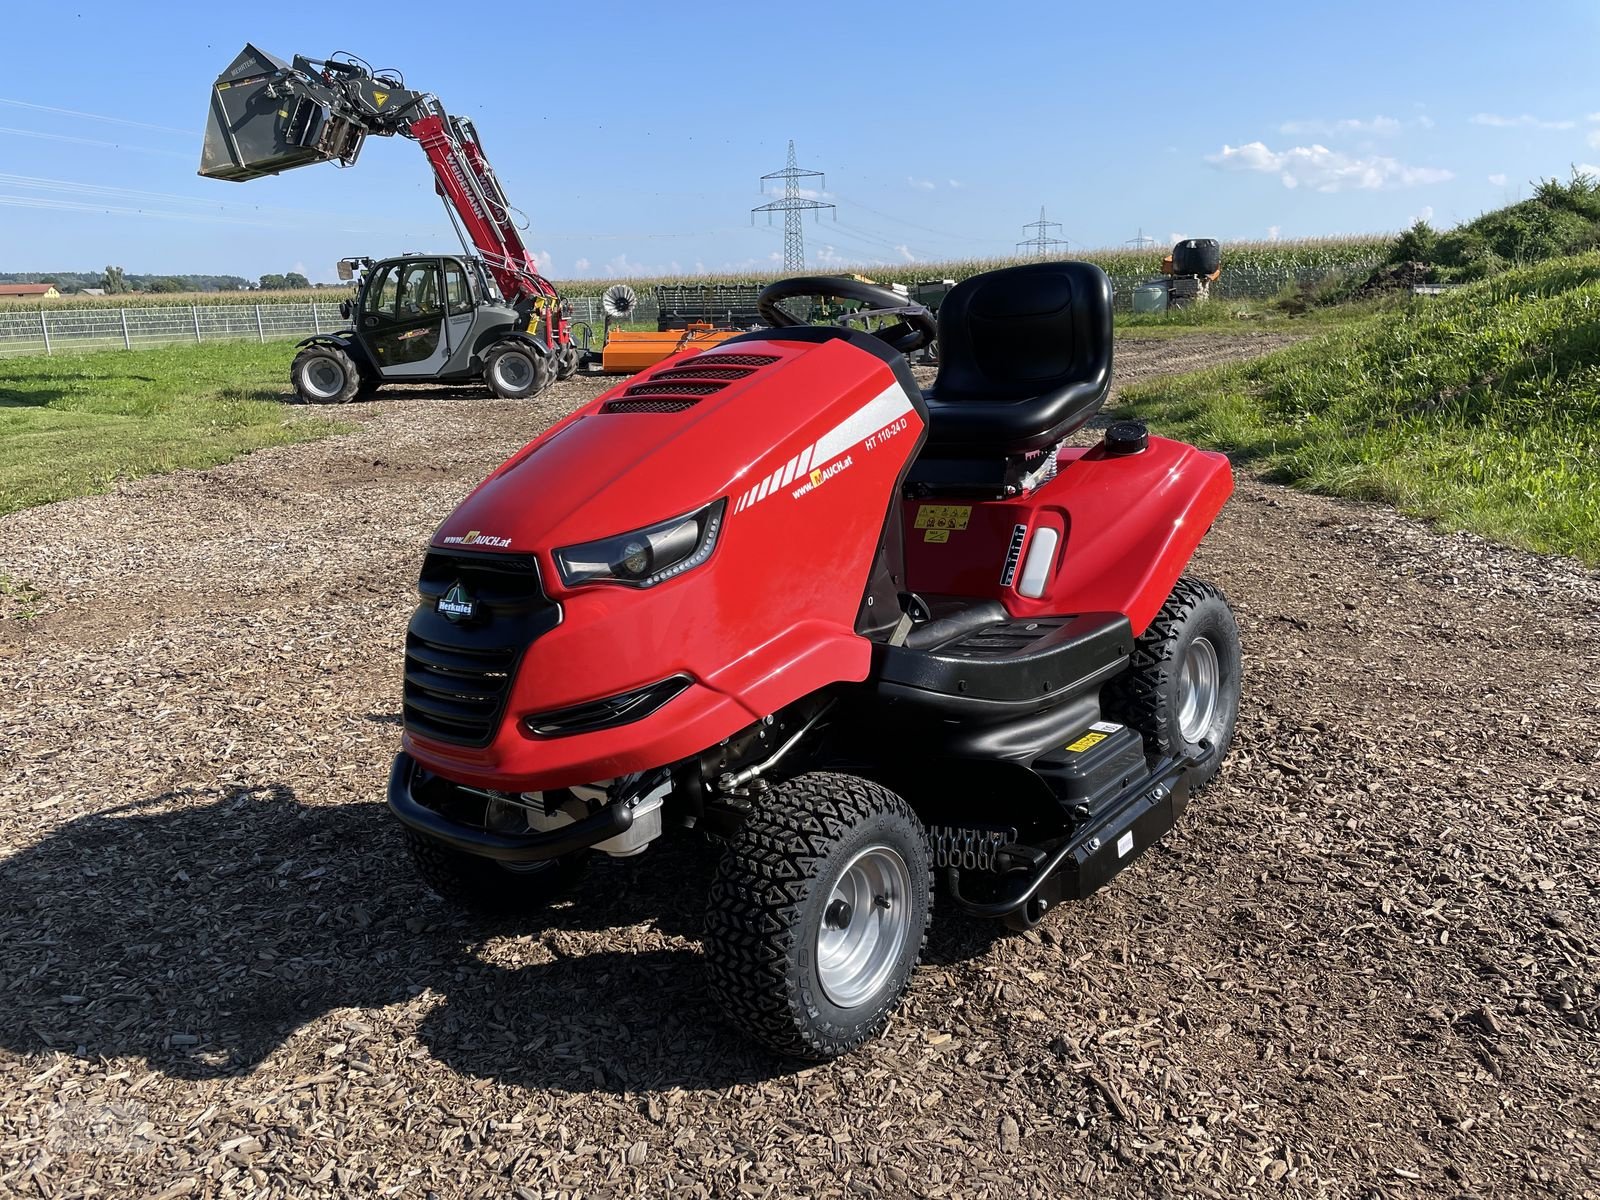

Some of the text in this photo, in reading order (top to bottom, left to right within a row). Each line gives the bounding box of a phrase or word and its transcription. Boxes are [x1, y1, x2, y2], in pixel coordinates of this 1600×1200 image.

[446, 152, 485, 220] WEIDEMANN
[865, 418, 908, 451] HT 110-24 D
[793, 456, 853, 499] www.MAUCH.at
[443, 530, 512, 548] www.MAUCH.at
[439, 601, 473, 615] Herkules
